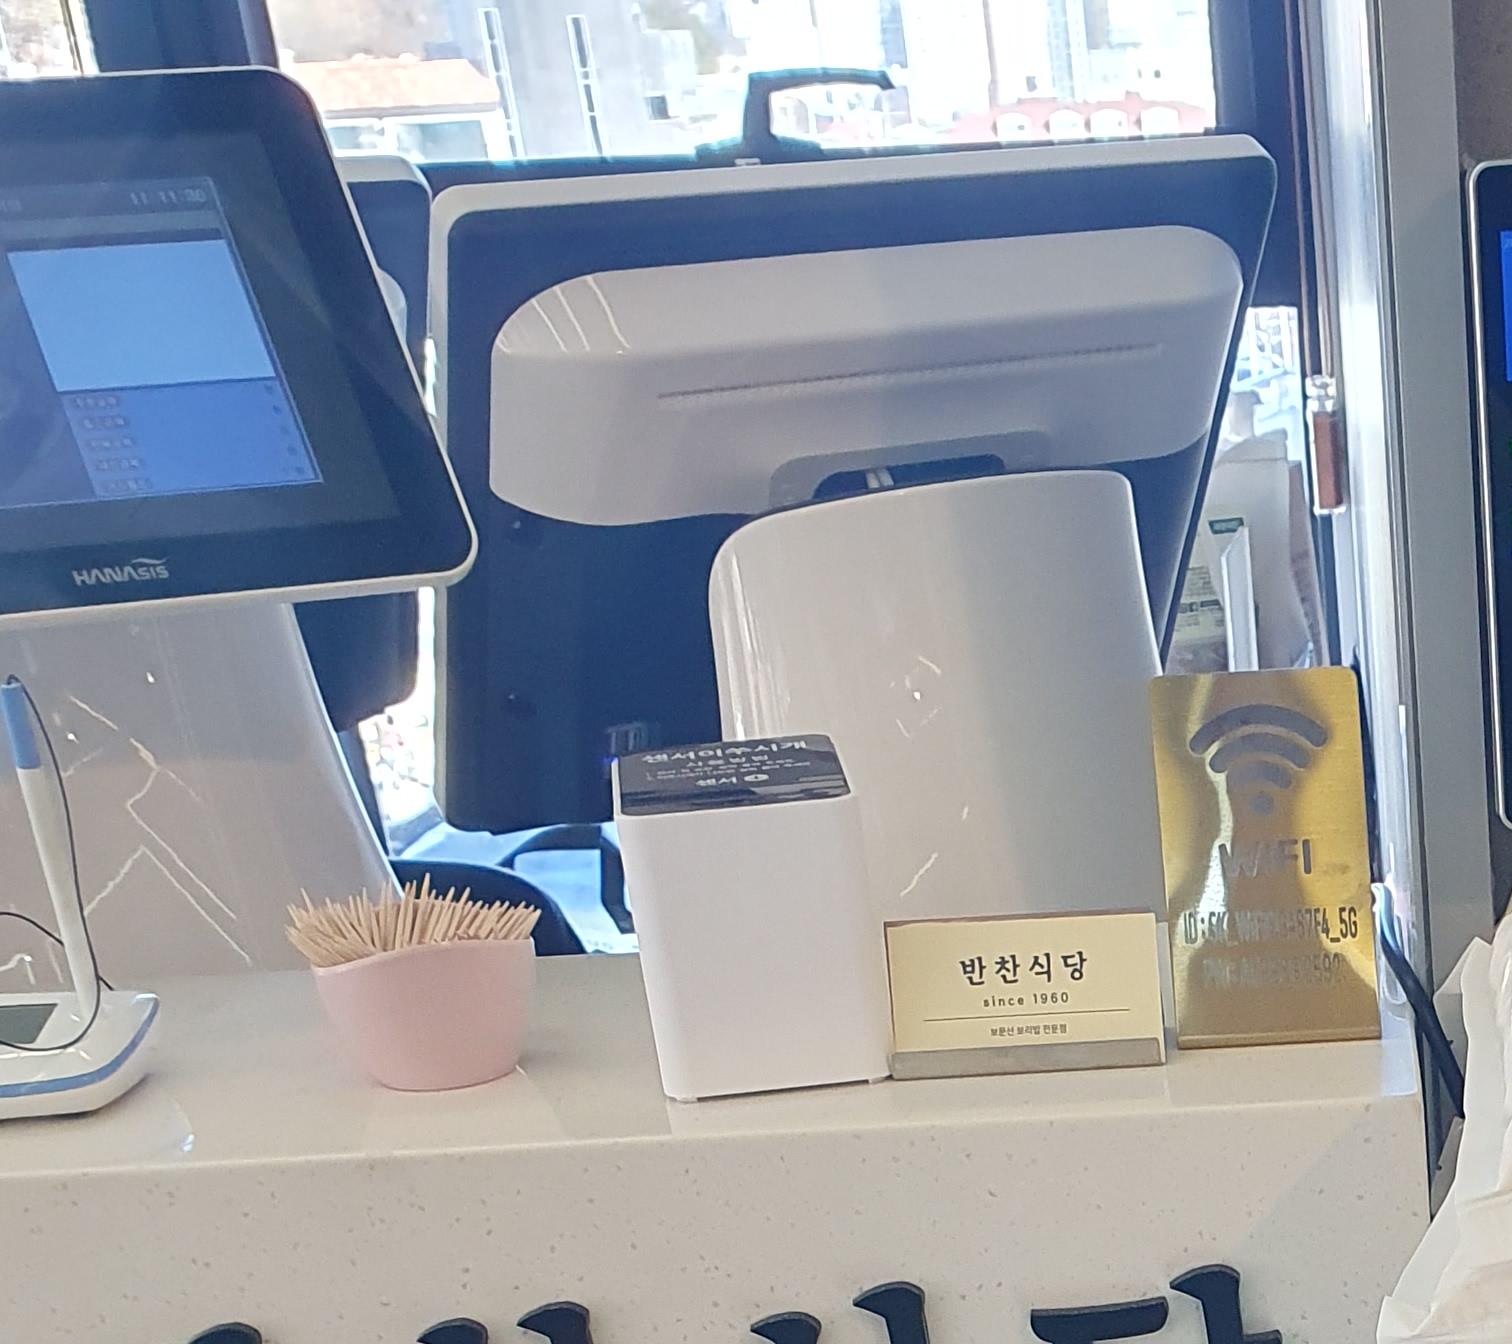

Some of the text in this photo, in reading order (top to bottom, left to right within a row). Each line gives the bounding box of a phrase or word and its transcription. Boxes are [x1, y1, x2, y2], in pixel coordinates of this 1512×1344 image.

[960, 950, 1088, 987] 반찬식당
[983, 991, 1069, 1008] since 1960
